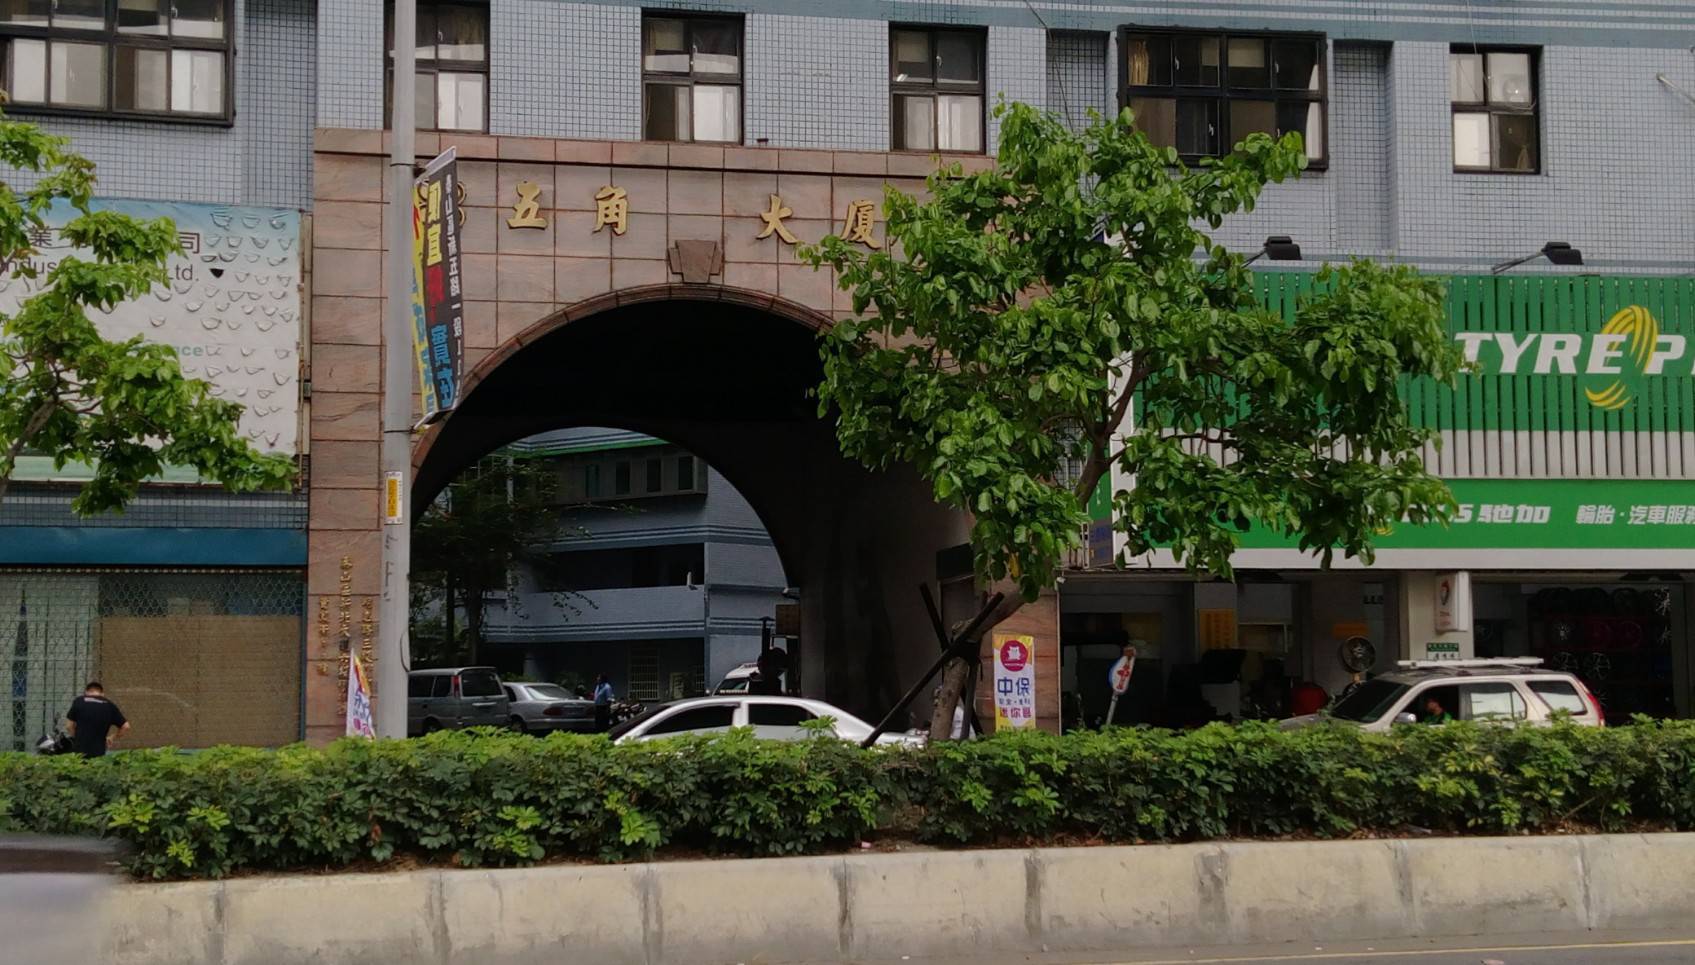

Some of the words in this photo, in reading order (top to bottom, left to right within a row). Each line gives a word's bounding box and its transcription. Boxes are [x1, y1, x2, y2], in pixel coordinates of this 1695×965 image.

[168, 264, 199, 281] td.
[1454, 332, 1695, 375] TYREP
[997, 676, 1030, 697] 中保
